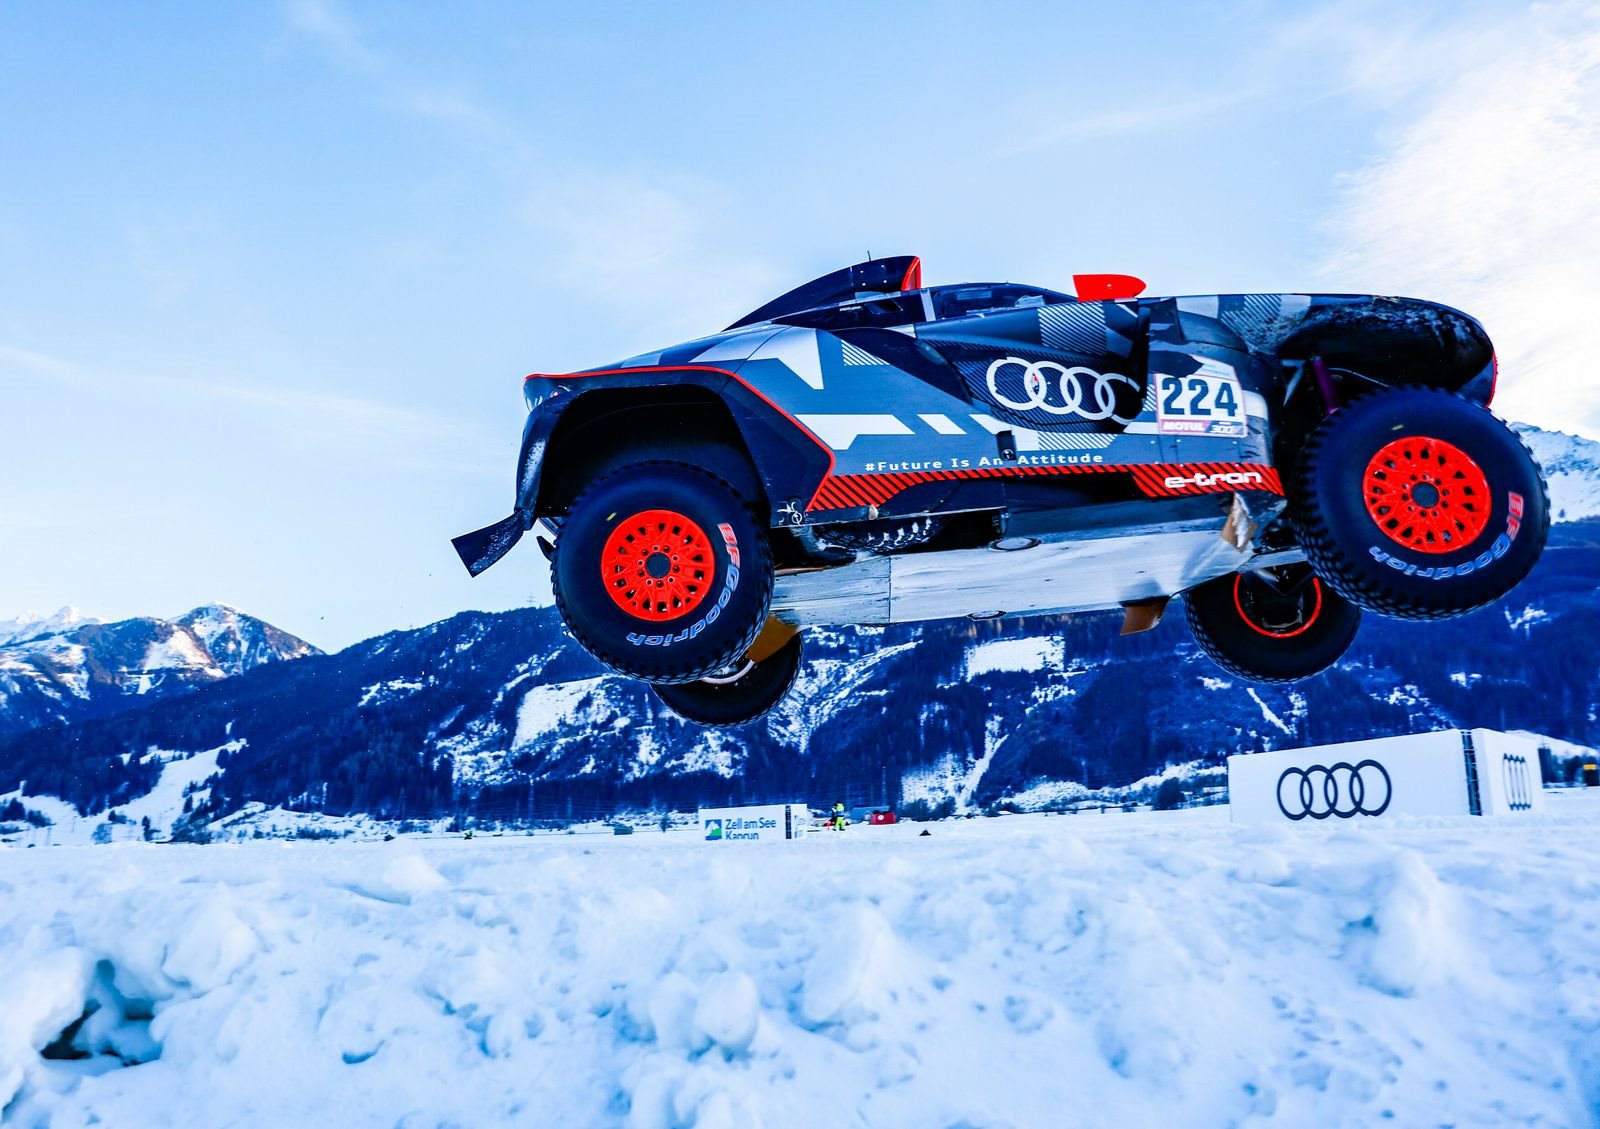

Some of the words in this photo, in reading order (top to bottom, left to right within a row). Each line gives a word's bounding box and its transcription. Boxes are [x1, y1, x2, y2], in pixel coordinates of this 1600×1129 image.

[1161, 377, 1238, 417] 224
[1162, 421, 1205, 431] MOTUL
[865, 459, 942, 472] #Future
[951, 457, 970, 468] Is
[978, 456, 1003, 466] An
[1017, 453, 1103, 465] Attitude
[1164, 471, 1263, 489] e-tron
[725, 818, 743, 830] Zell
[743, 820, 758, 829] am
[758, 817, 777, 829] See
